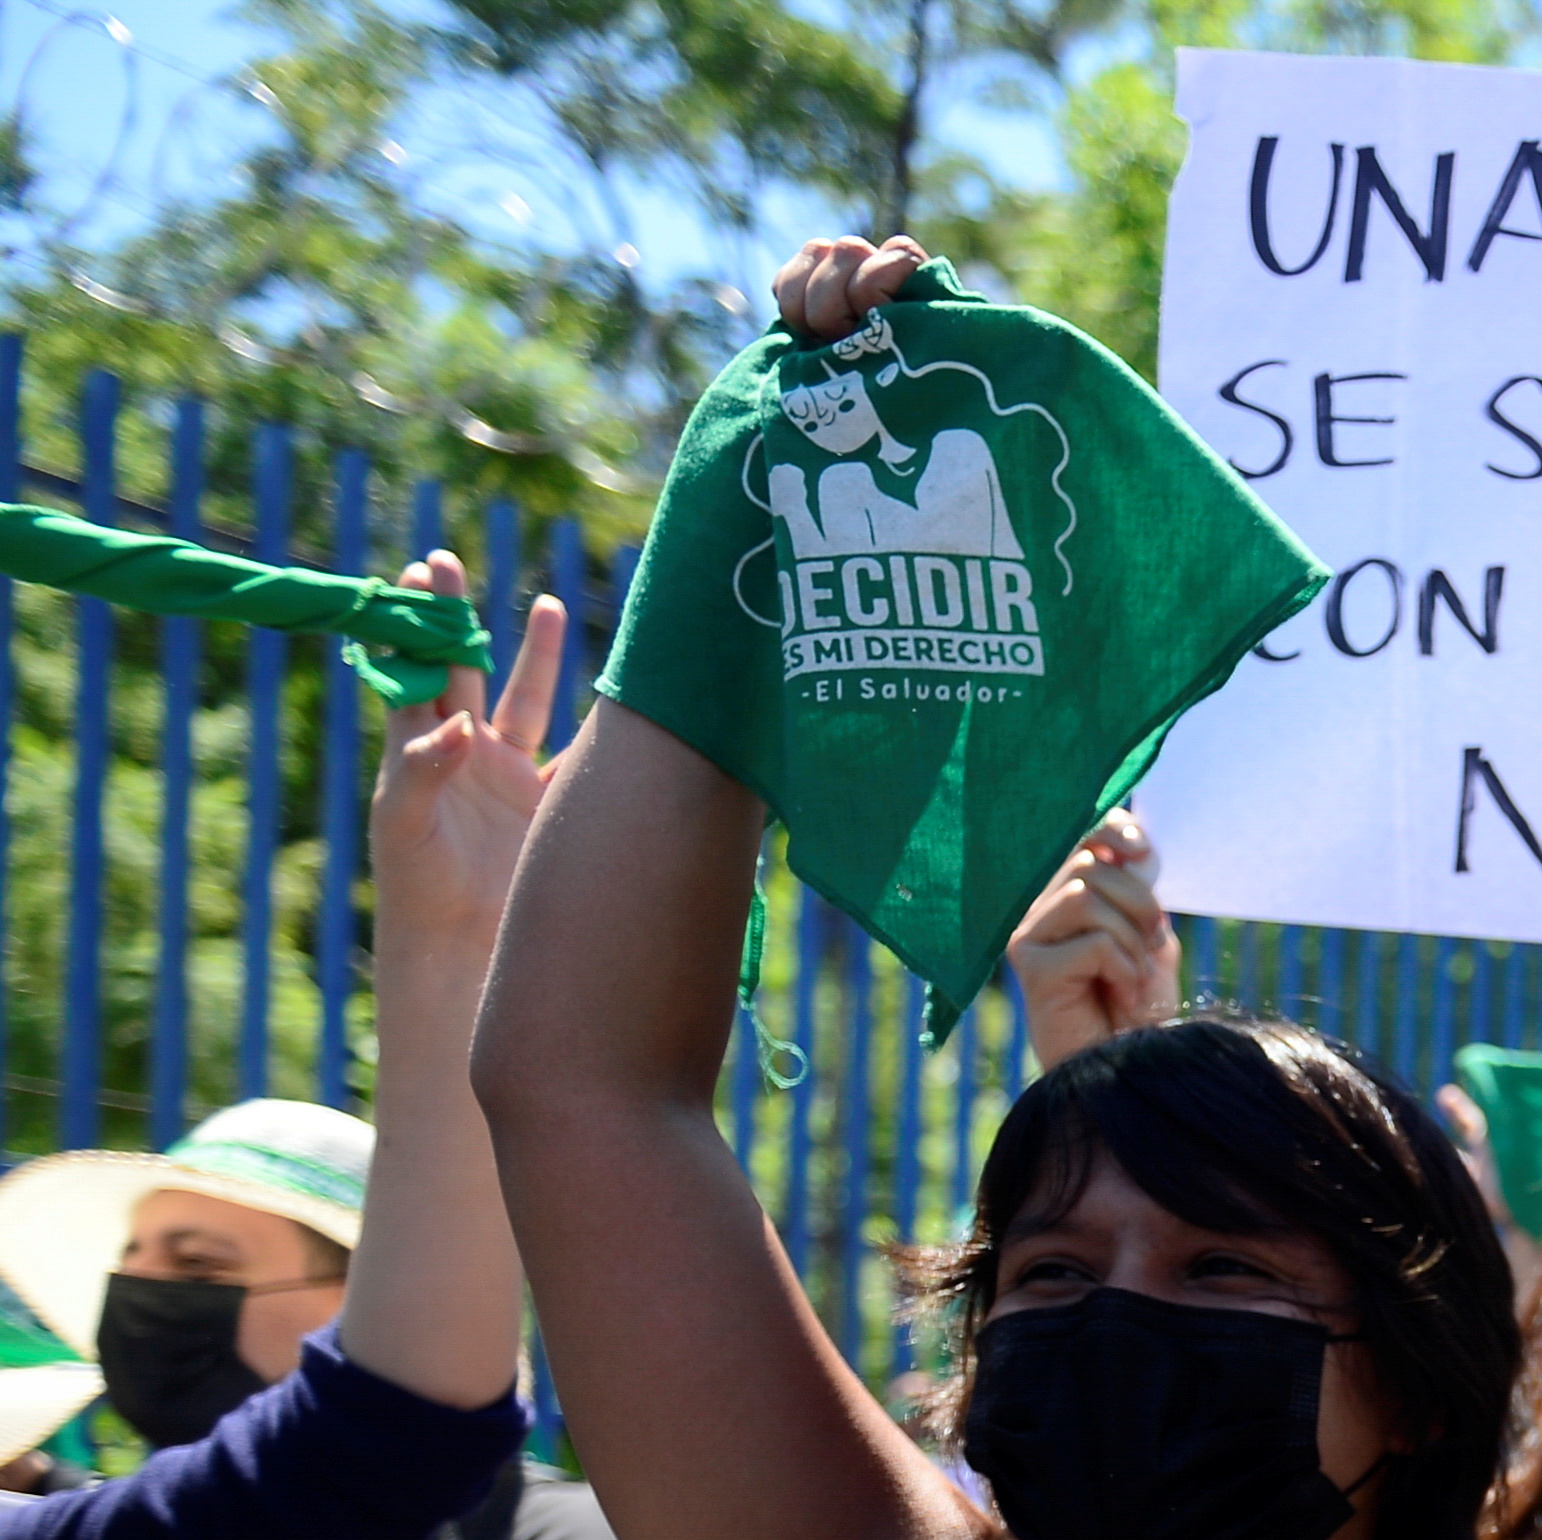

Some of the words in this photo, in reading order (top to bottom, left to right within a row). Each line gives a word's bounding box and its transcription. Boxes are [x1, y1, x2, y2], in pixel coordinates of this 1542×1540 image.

[1219, 360, 1408, 479] SE
[813, 637, 854, 664] MI
[863, 636, 1036, 666] DERECHO
[1253, 558, 1505, 662] ON
